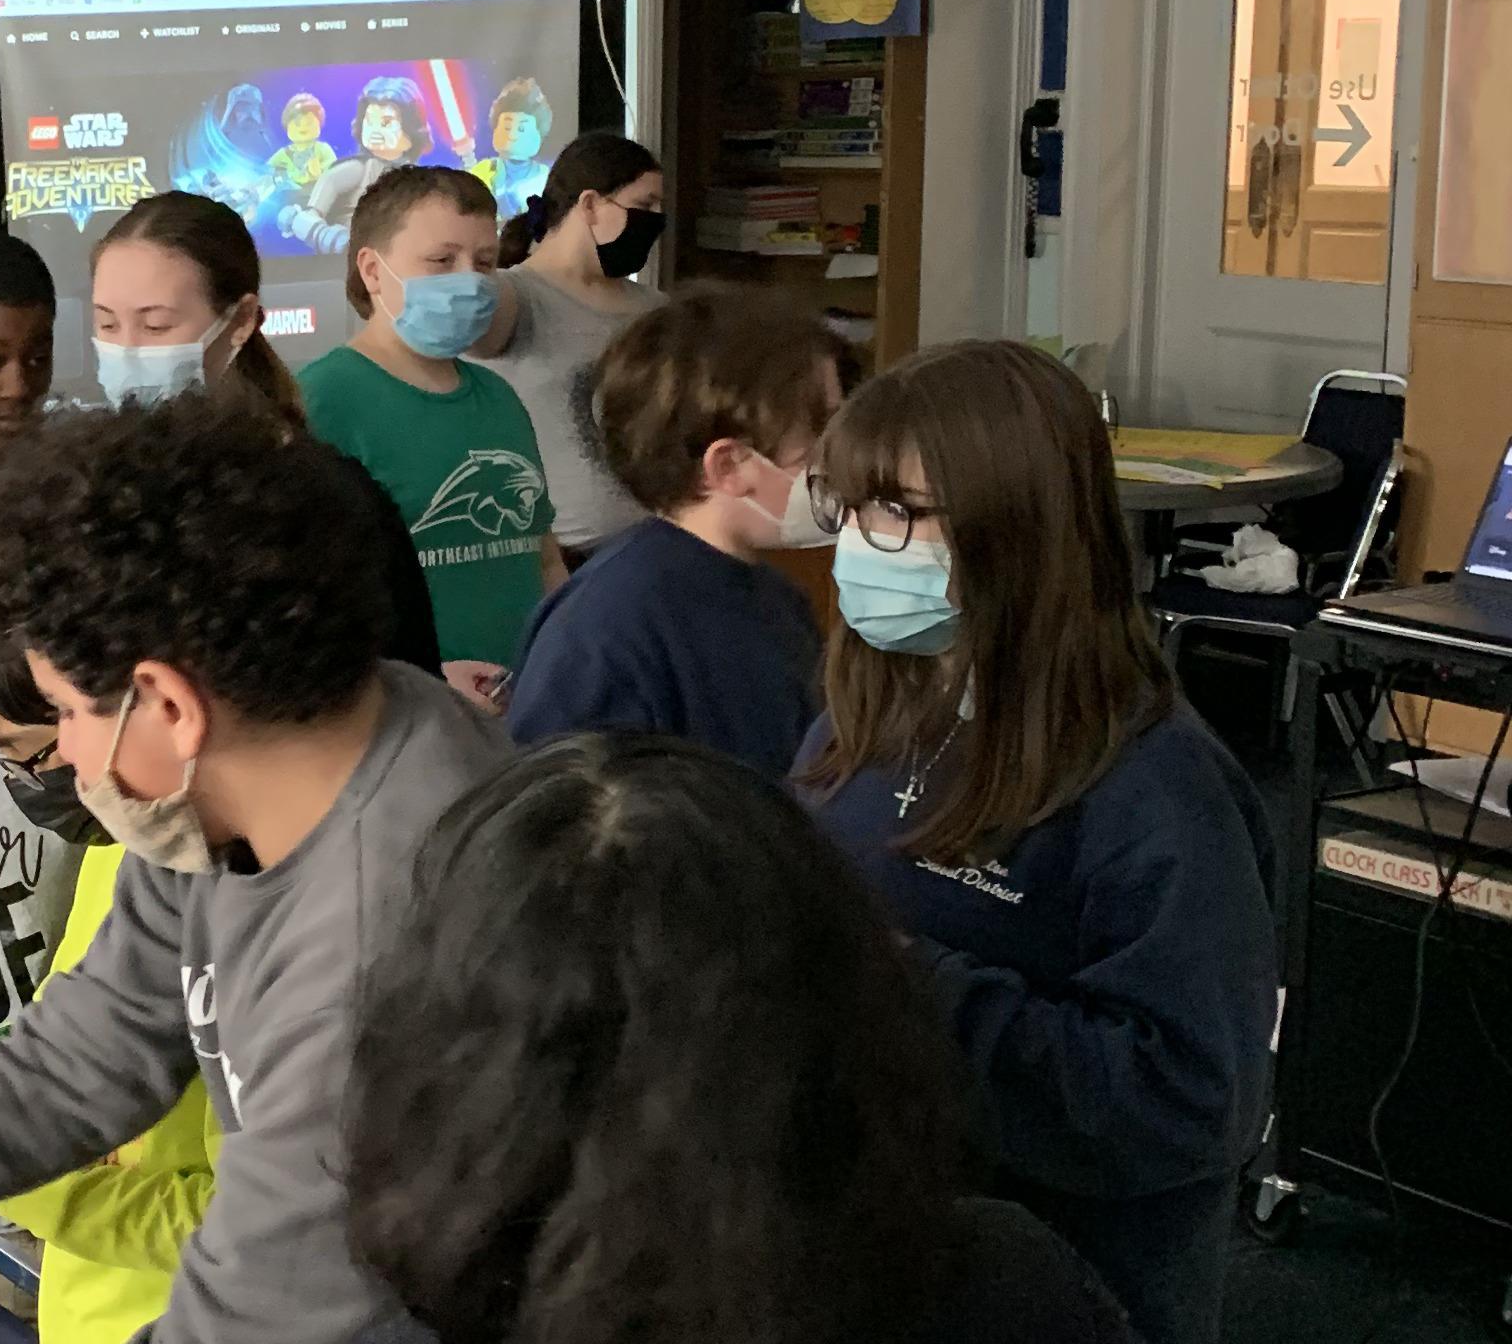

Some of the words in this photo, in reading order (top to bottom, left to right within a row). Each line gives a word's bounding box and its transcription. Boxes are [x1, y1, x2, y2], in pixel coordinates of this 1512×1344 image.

[22, 32, 48, 43] HOME
[85, 29, 120, 40] SEARCH
[63, 113, 128, 132] STAR
[64, 130, 128, 149] WARS
[8, 157, 154, 193] FREEMAKER
[260, 308, 315, 336] MARVEL
[418, 543, 484, 568] ORTHEAST
[1326, 846, 1377, 874] CLOCK
[1382, 862, 1432, 888] CLASS
